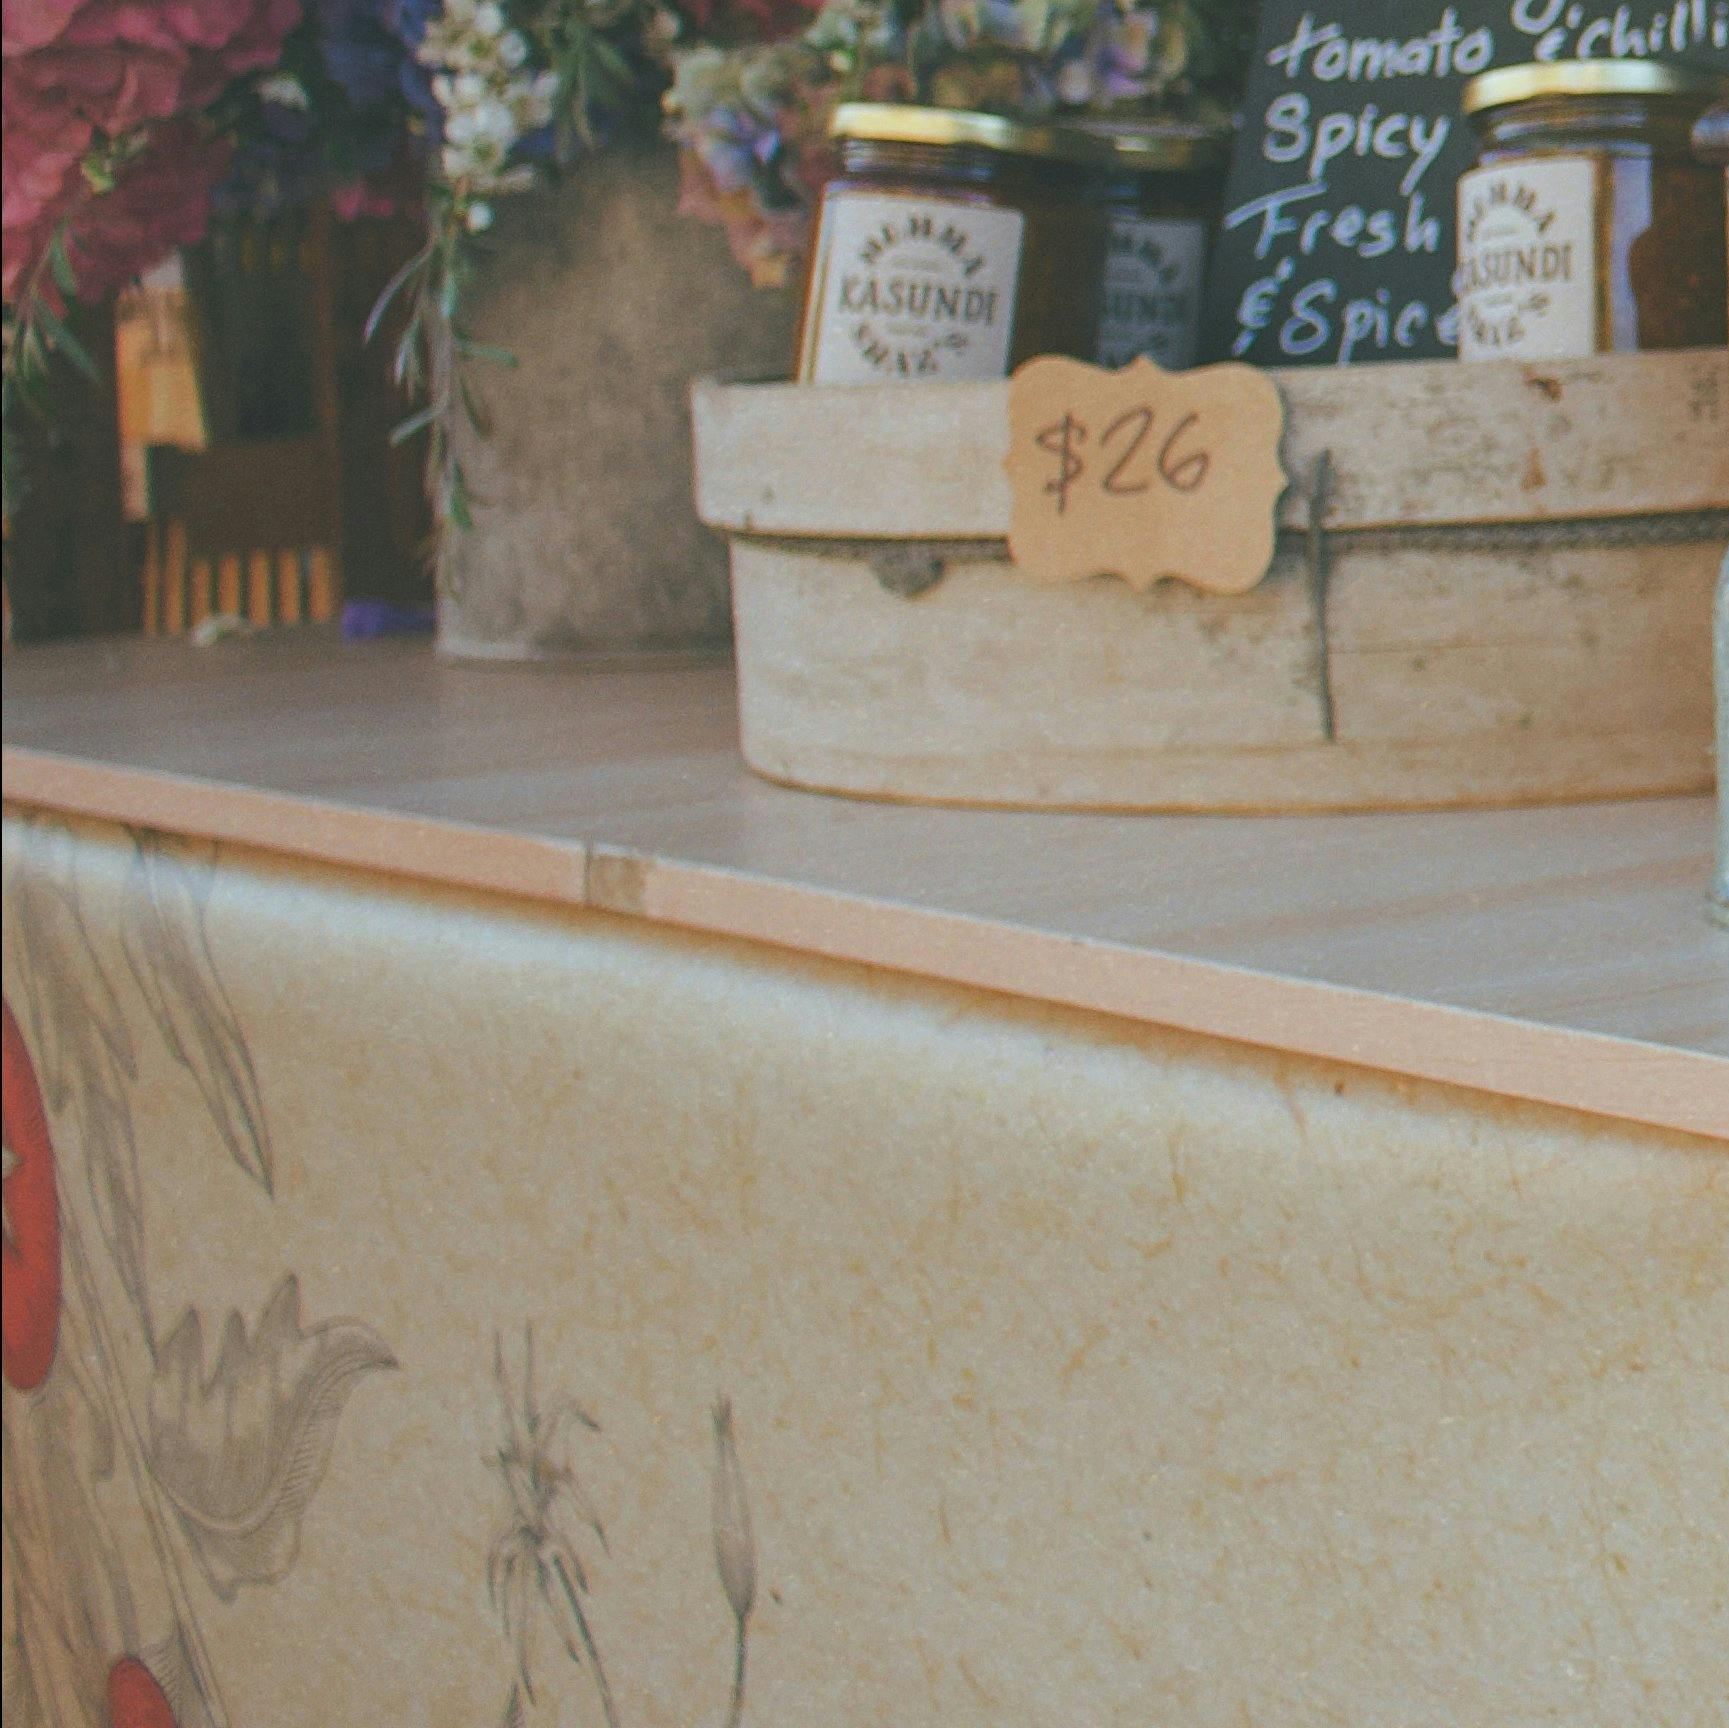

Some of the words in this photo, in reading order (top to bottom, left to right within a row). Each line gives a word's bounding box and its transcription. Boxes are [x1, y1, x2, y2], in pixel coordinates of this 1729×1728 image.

[1268, 7, 1494, 82] tomato
[1263, 92, 1449, 196] Spicy
[1224, 180, 1441, 260] Fresh
[838, 275, 1000, 328] KASUNDI
[1034, 407, 1210, 515] $26
